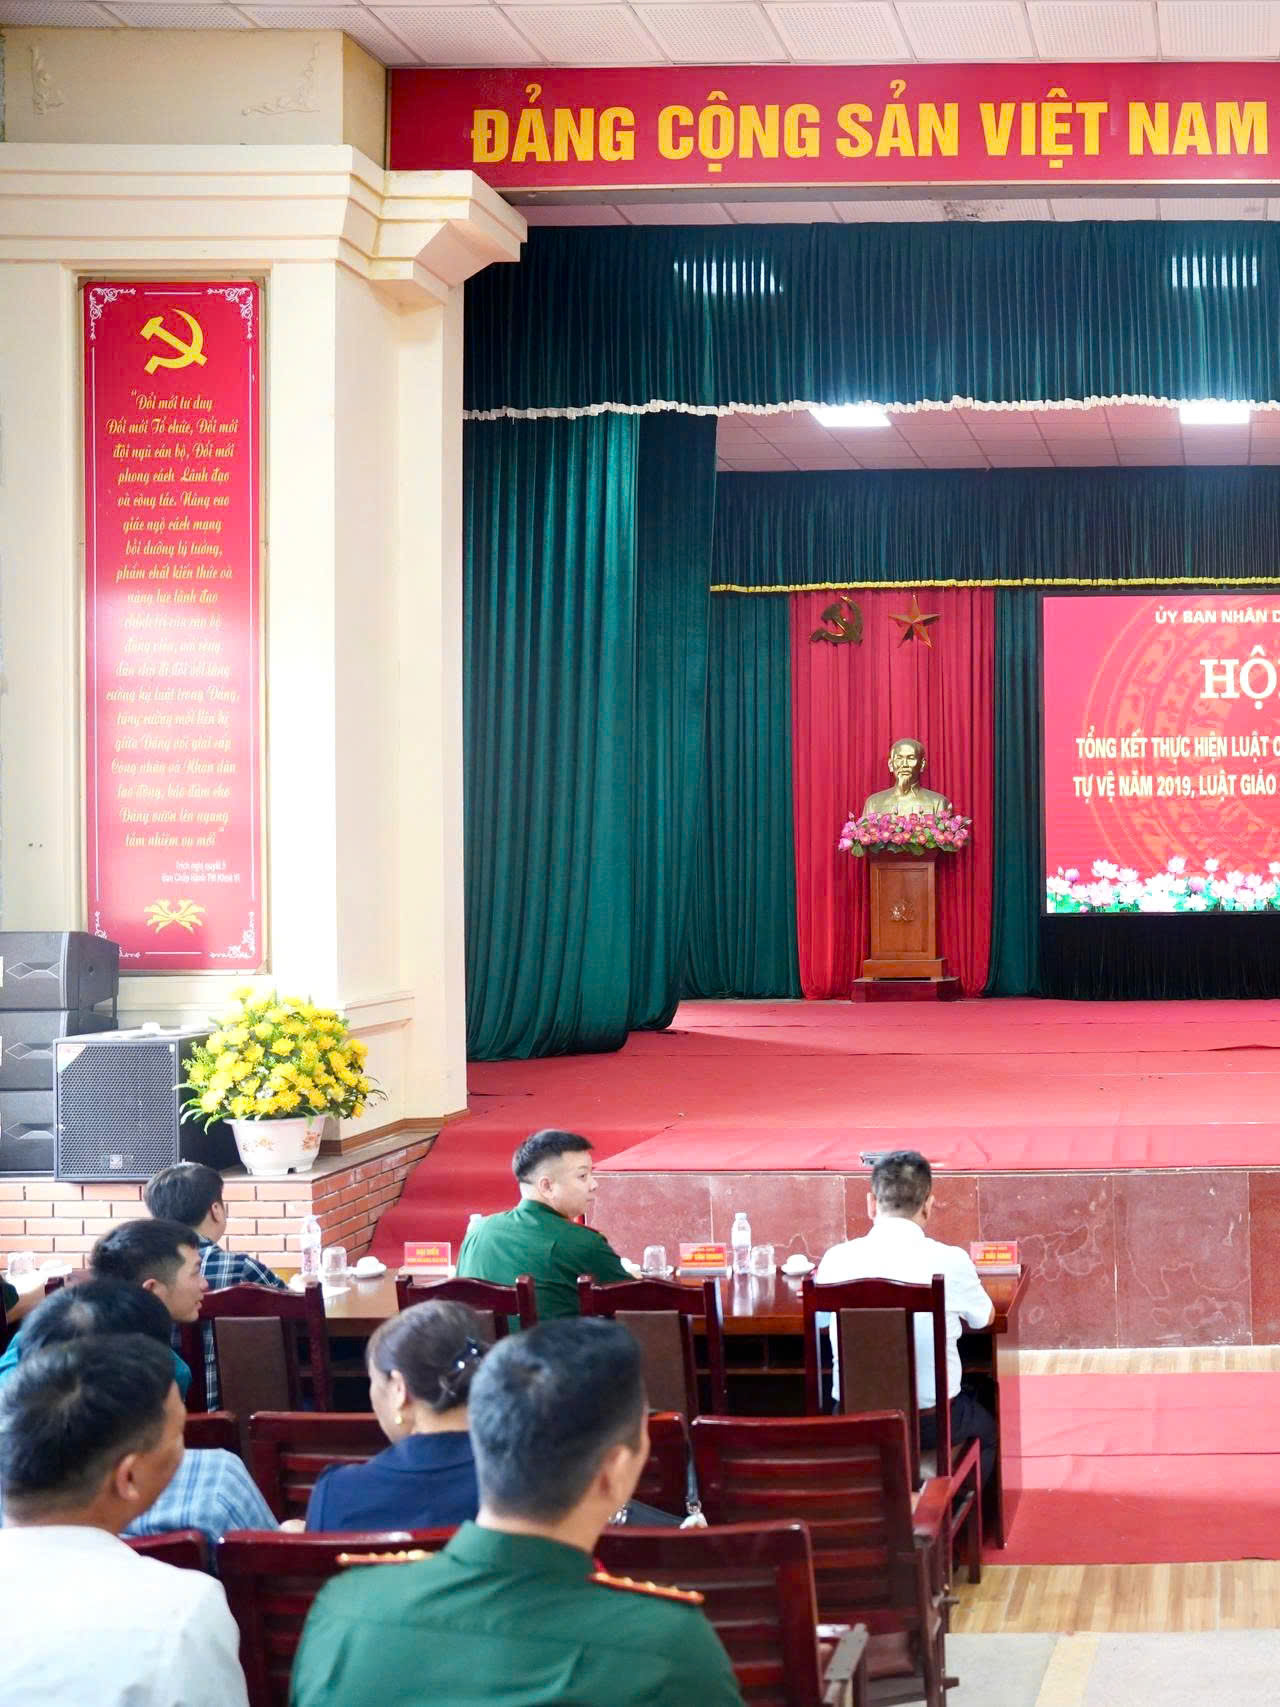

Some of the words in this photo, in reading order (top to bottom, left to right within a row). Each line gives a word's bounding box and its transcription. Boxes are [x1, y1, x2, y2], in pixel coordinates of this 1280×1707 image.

[471, 84, 635, 163] ĐẢNG
[658, 91, 820, 173] CỘNG
[836, 79, 959, 158] SẢN
[979, 88, 1108, 169] VIỆT
[1129, 101, 1268, 156] NAM
[1155, 606, 1178, 624] ỦY
[1183, 610, 1216, 623] BAN
[1221, 607, 1267, 623] NHÂN
[1076, 726, 1116, 758] TỔNG
[1121, 728, 1147, 758] KẾT
[1151, 736, 1190, 764] THỰC
[1194, 731, 1227, 763] HIỆN
[1232, 730, 1269, 762] LUẬT
[1073, 774, 1093, 803] TỰ
[1097, 771, 1115, 803] VỆ
[1119, 770, 1152, 797] NĂM
[1157, 776, 1194, 798] 2019,
[1200, 770, 1236, 802] LUẬT
[1240, 769, 1276, 795] GIÁO
